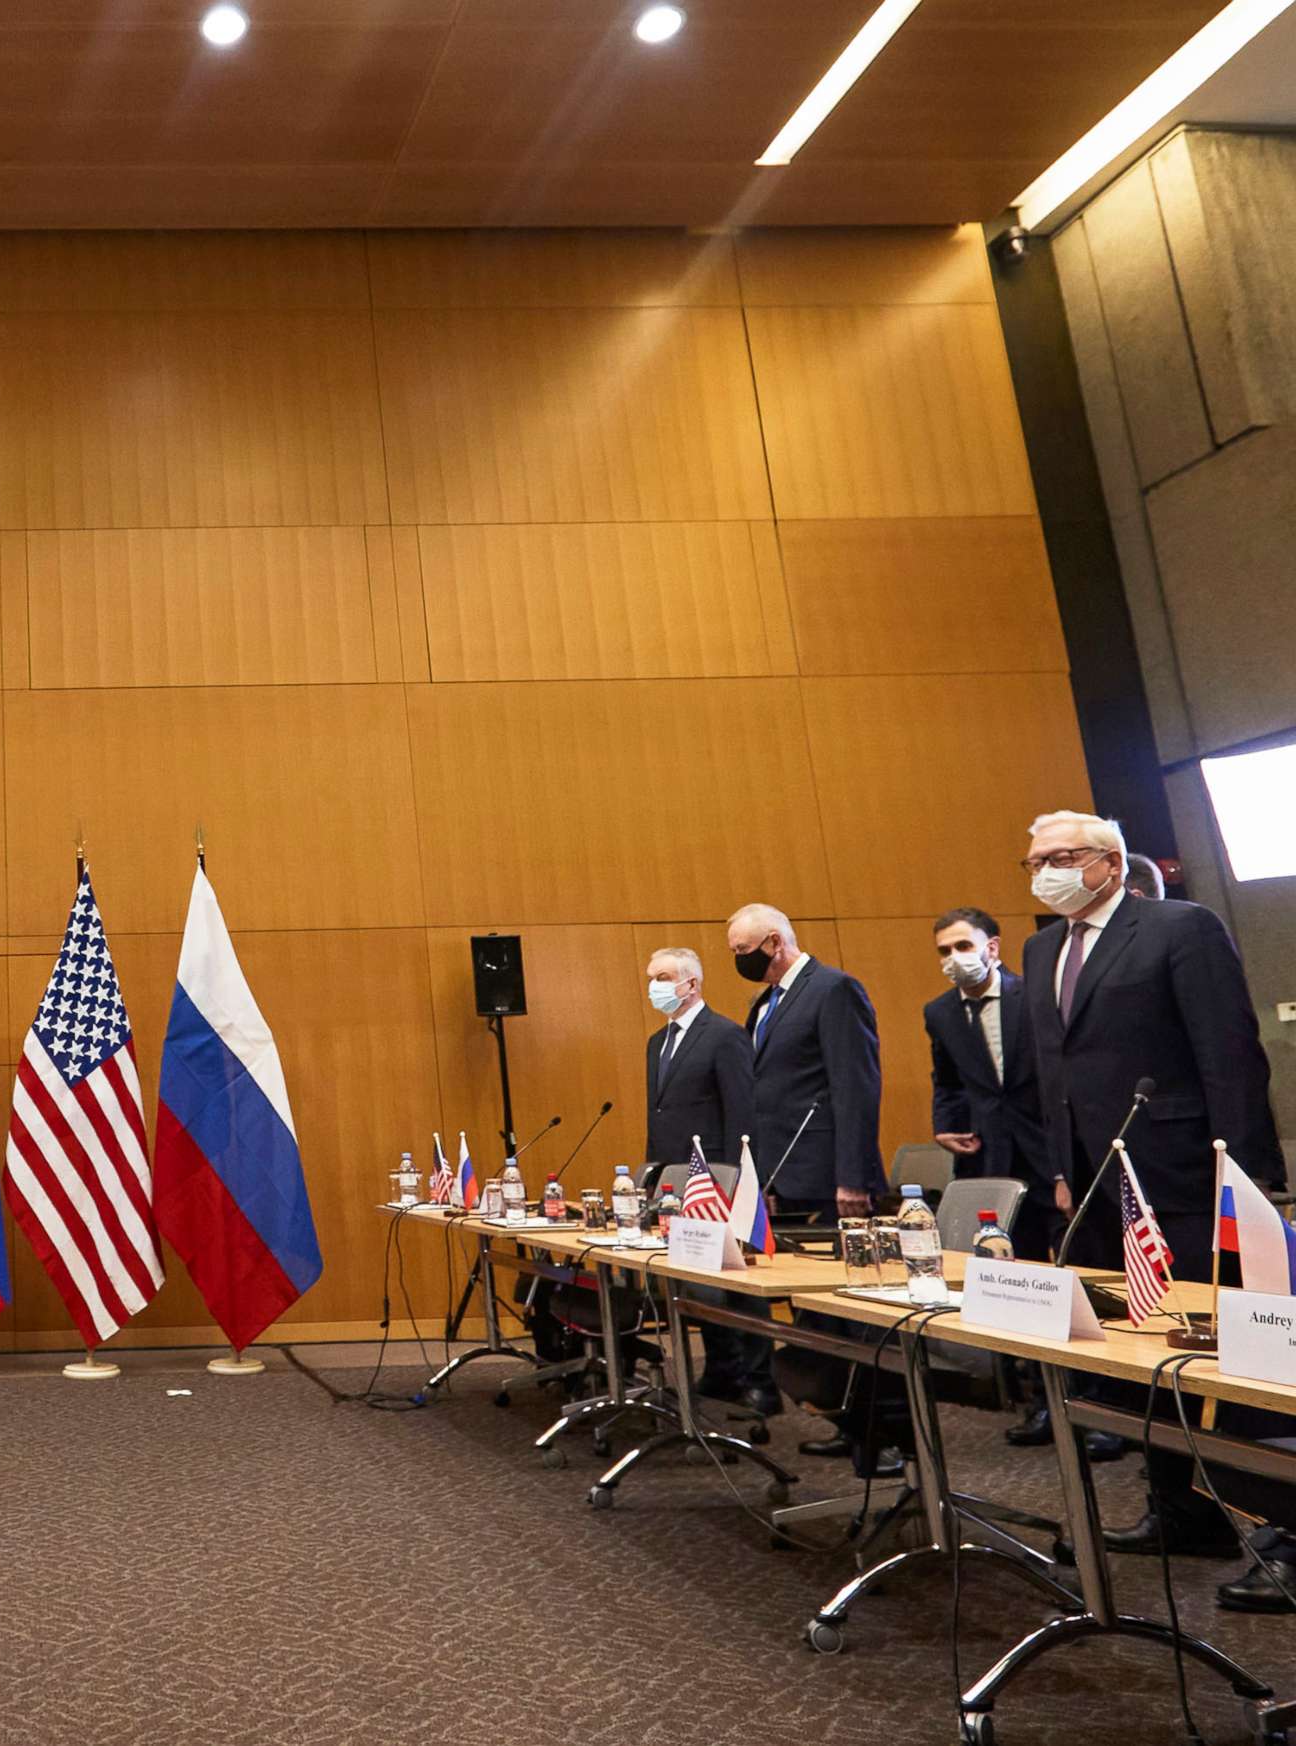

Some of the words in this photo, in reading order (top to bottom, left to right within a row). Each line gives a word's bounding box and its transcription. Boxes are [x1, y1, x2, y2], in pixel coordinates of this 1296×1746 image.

[998, 1274, 1029, 1291] Gennady
[1032, 1279, 1059, 1292] Gatilov
[1249, 1311, 1293, 1330] Andrey
